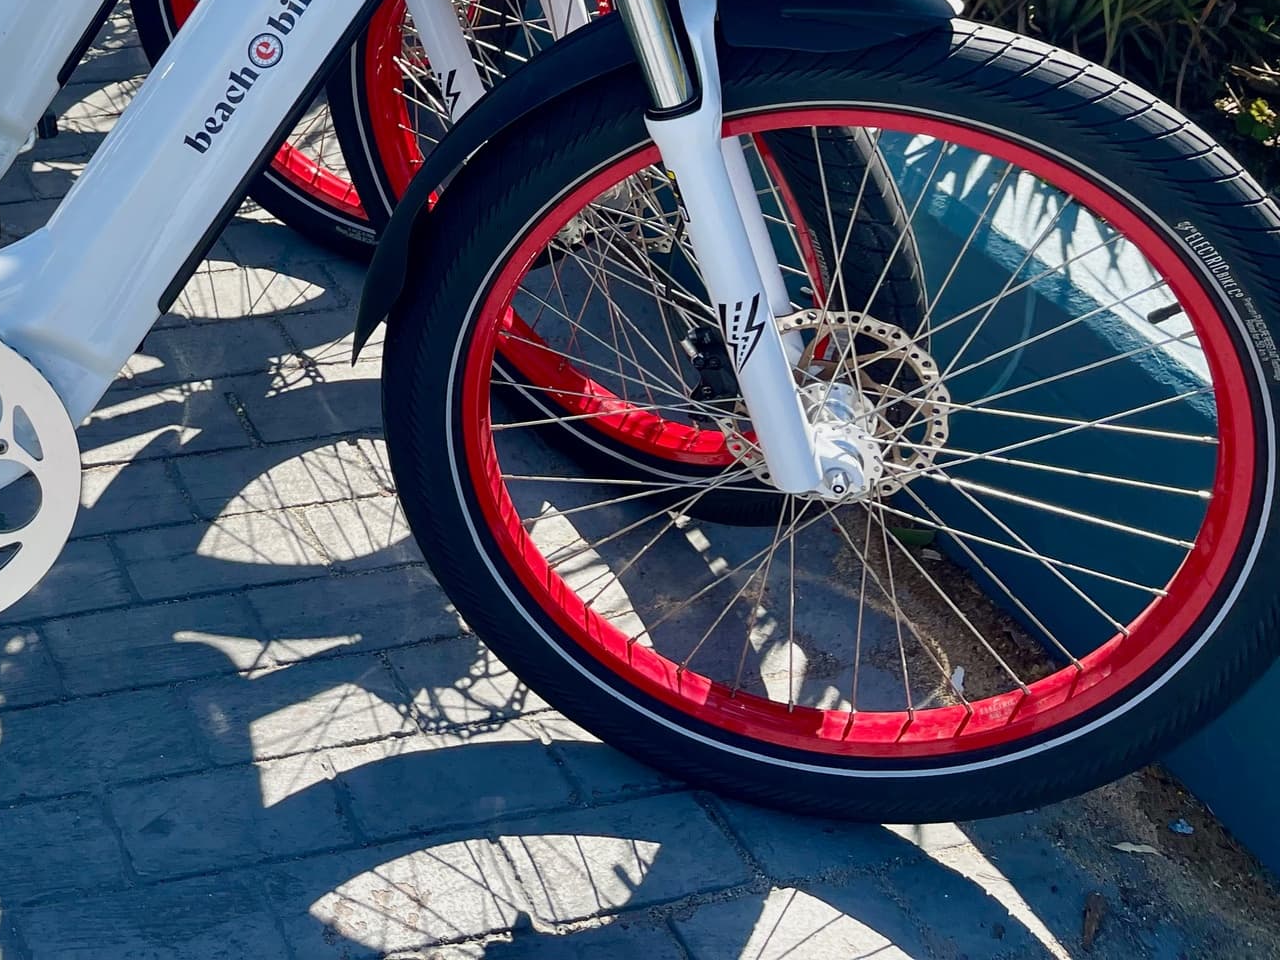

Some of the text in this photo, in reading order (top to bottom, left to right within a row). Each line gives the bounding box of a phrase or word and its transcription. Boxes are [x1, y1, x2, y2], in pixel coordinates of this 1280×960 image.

[183, 66, 260, 154] beach
[1185, 231, 1230, 276] ELECTRIC
[1218, 269, 1238, 290] BIKE
